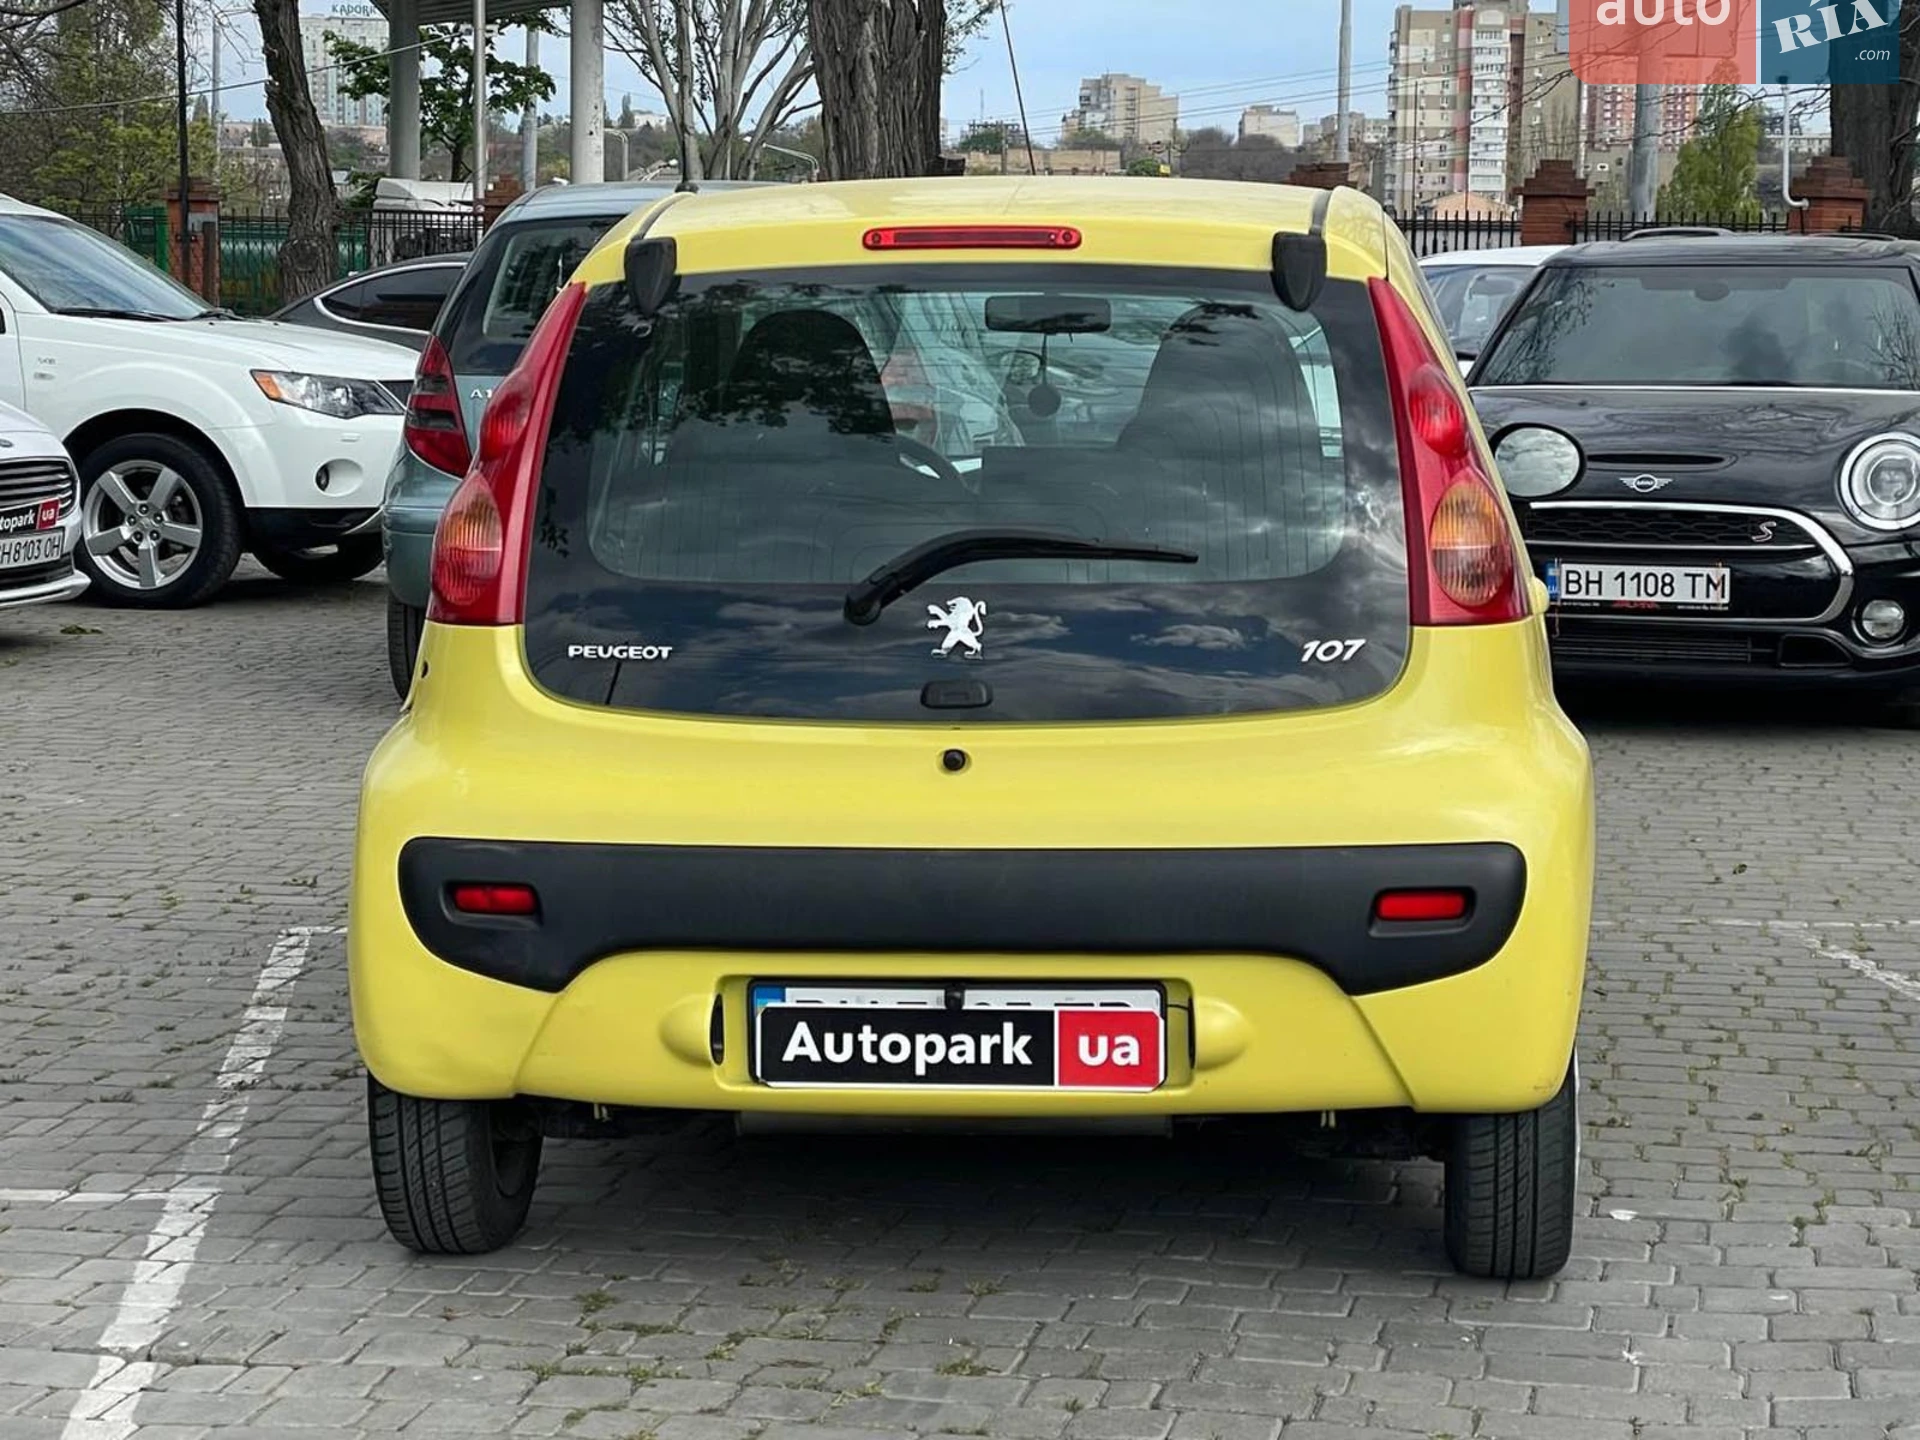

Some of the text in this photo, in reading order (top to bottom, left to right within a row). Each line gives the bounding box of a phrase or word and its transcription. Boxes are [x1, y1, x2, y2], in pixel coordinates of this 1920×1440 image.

[41, 508, 55, 521] ua
[1751, 521, 1777, 542] S
[13, 538, 41, 563] 8103
[44, 536, 62, 558] OH
[1565, 570, 1726, 599] BH 1108 TM
[568, 645, 673, 660] PEUGEOT
[1301, 639, 1367, 662] 107
[782, 1021, 1140, 1075] Autopark ua
